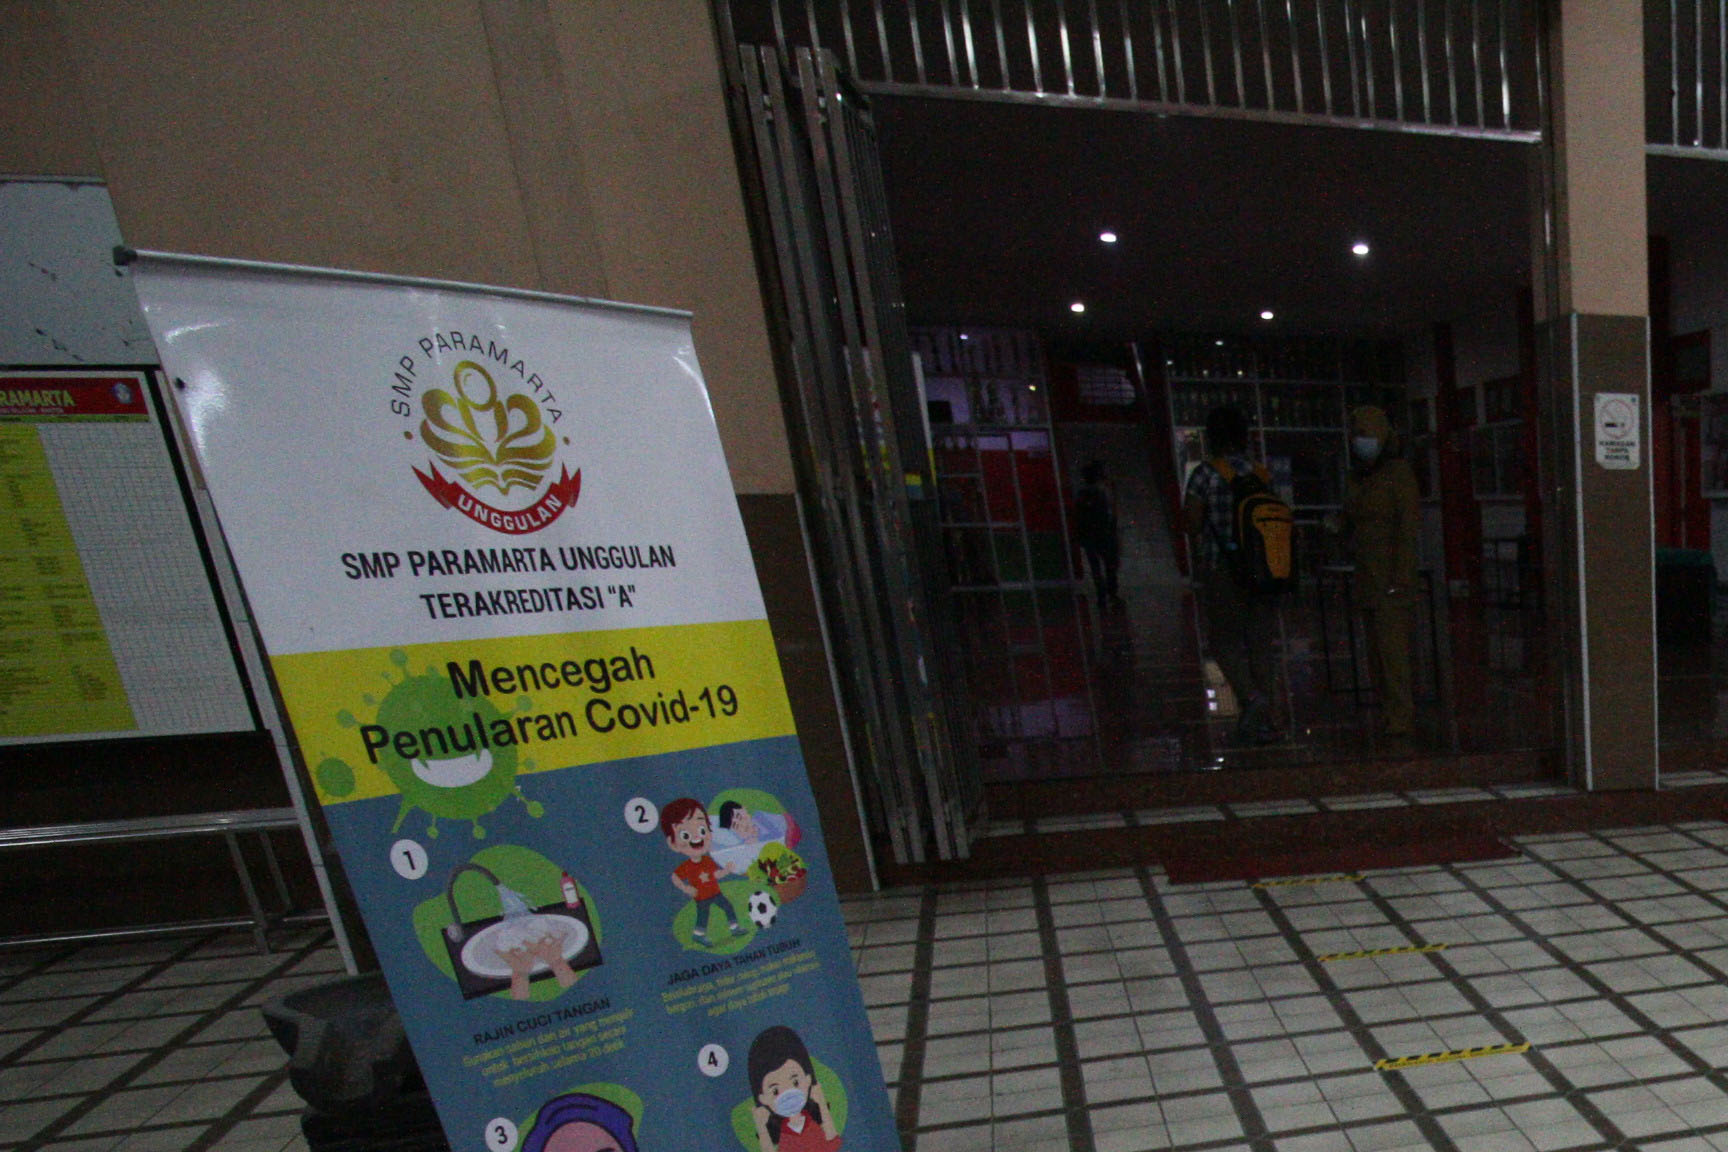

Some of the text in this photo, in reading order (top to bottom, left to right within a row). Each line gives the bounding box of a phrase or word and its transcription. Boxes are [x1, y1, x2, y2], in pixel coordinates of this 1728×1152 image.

[391, 331, 562, 424] SMP PARAMARTA
[457, 493, 562, 531] UNGGULAN
[341, 544, 676, 579] SMP PARAMARTA UNGGULAN
[420, 585, 604, 619] TERAKREDITASI
[446, 646, 655, 700] Mencegah
[360, 684, 739, 764] Penularan Covid-19
[634, 805, 648, 824] 2
[403, 850, 416, 871] 1
[668, 968, 699, 985] JAGA
[702, 960, 732, 977] DAYA
[473, 998, 610, 1045] RAJIN CUCI TANGAN
[707, 1051, 718, 1068] 4
[495, 1125, 508, 1144] 3
